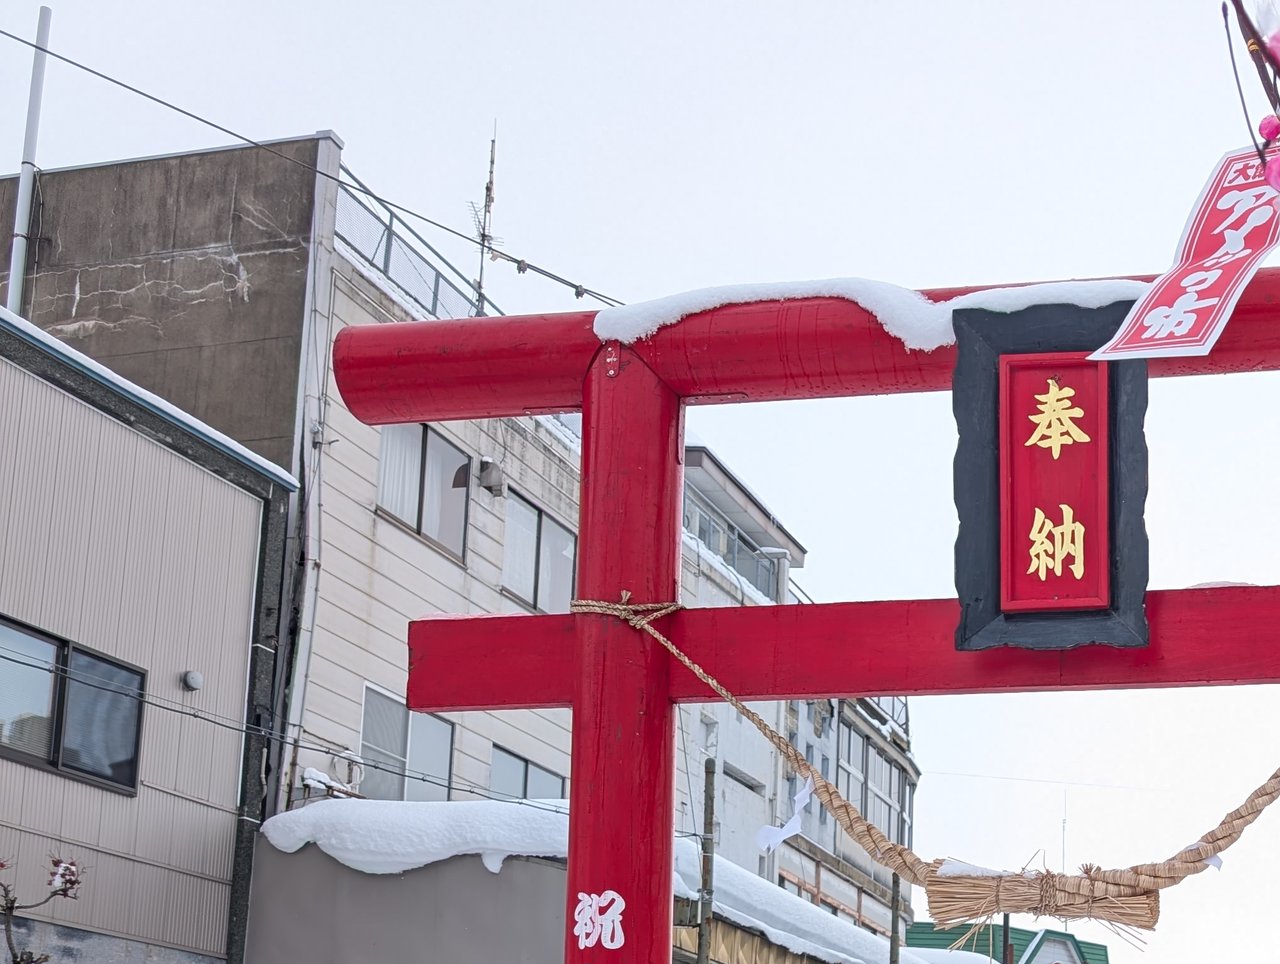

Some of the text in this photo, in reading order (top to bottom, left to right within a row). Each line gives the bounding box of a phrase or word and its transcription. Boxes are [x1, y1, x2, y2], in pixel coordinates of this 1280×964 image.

[1141, 184, 1278, 340] アメッコ市
[1024, 378, 1092, 582] 奉納
